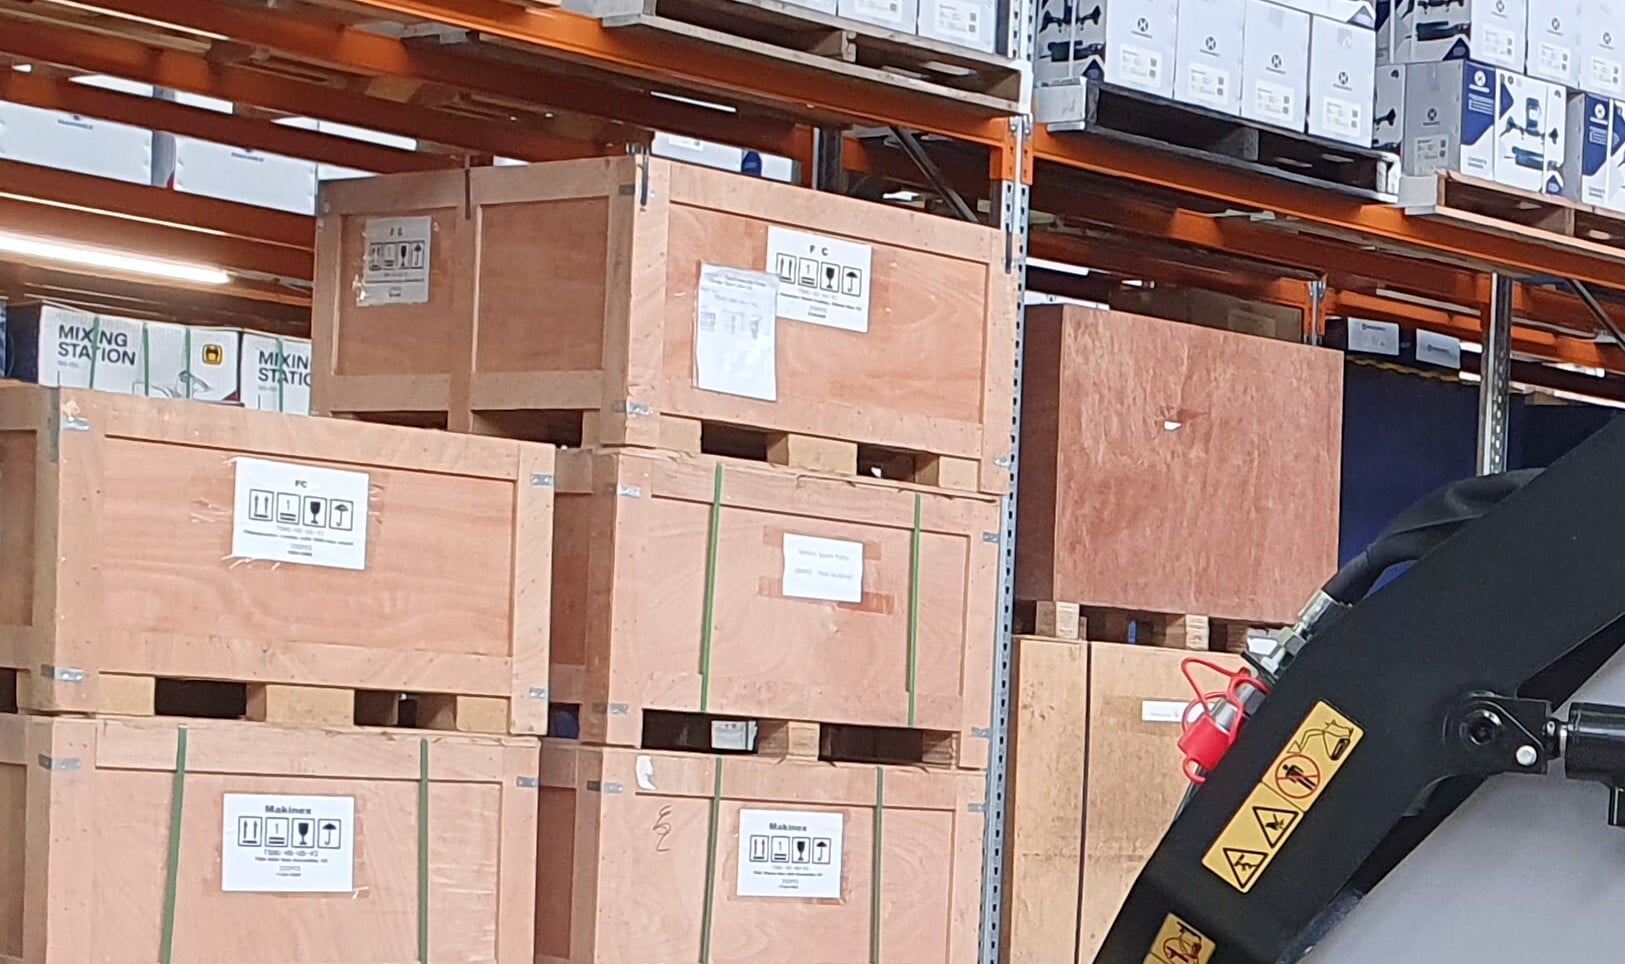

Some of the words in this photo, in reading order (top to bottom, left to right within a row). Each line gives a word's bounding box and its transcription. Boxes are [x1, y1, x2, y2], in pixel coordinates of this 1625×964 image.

[58, 324, 127, 347] MIXNG
[57, 341, 136, 365] STAION
[258, 350, 309, 370] MIXIN
[264, 804, 312, 815] Makinex
